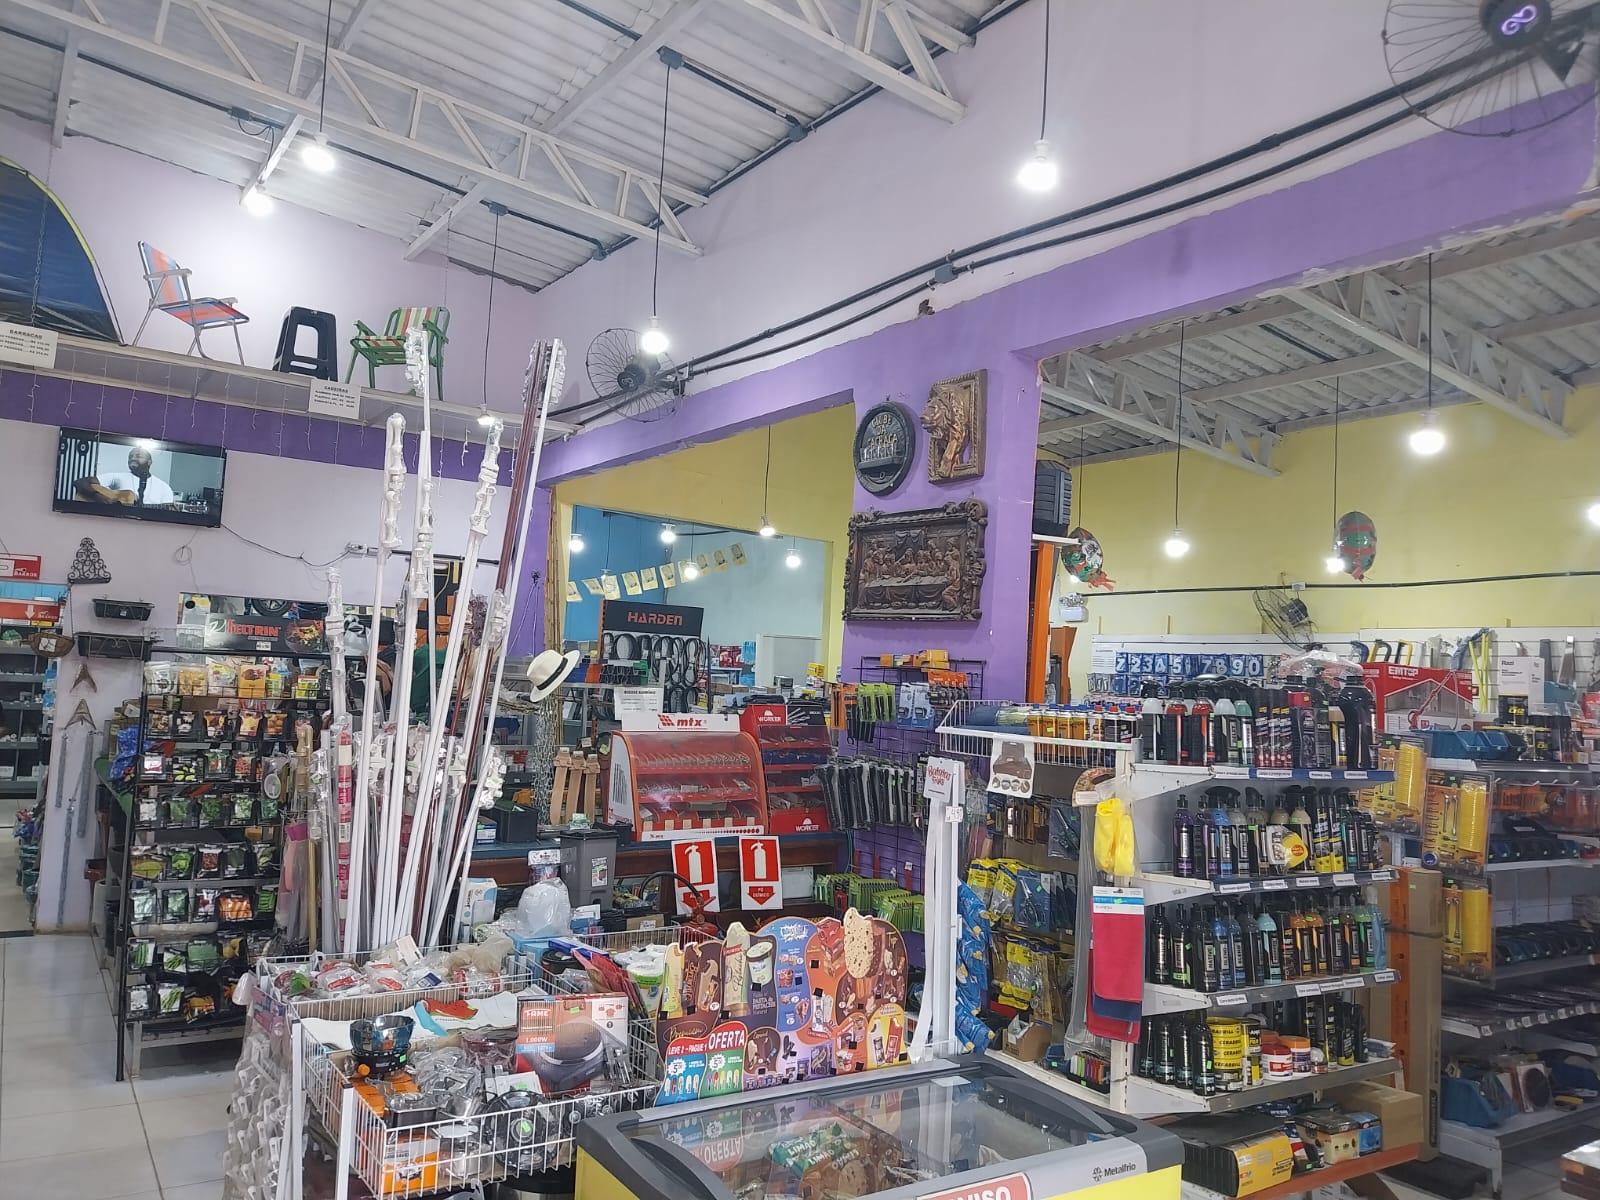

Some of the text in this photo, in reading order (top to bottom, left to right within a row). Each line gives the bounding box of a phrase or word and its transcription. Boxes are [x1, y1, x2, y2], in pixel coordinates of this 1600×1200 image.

[627, 611, 684, 626] HARDEN
[227, 618, 280, 637] FELTRIN
[676, 717, 703, 727] mtx
[758, 715, 782, 723] WORKER
[795, 824, 819, 832] WORKER
[708, 1029, 745, 1050] OFERTA
[668, 1045, 680, 1055] LEVE
[688, 1043, 704, 1053] PAGUE
[1104, 1162, 1137, 1177] Metalfrio
